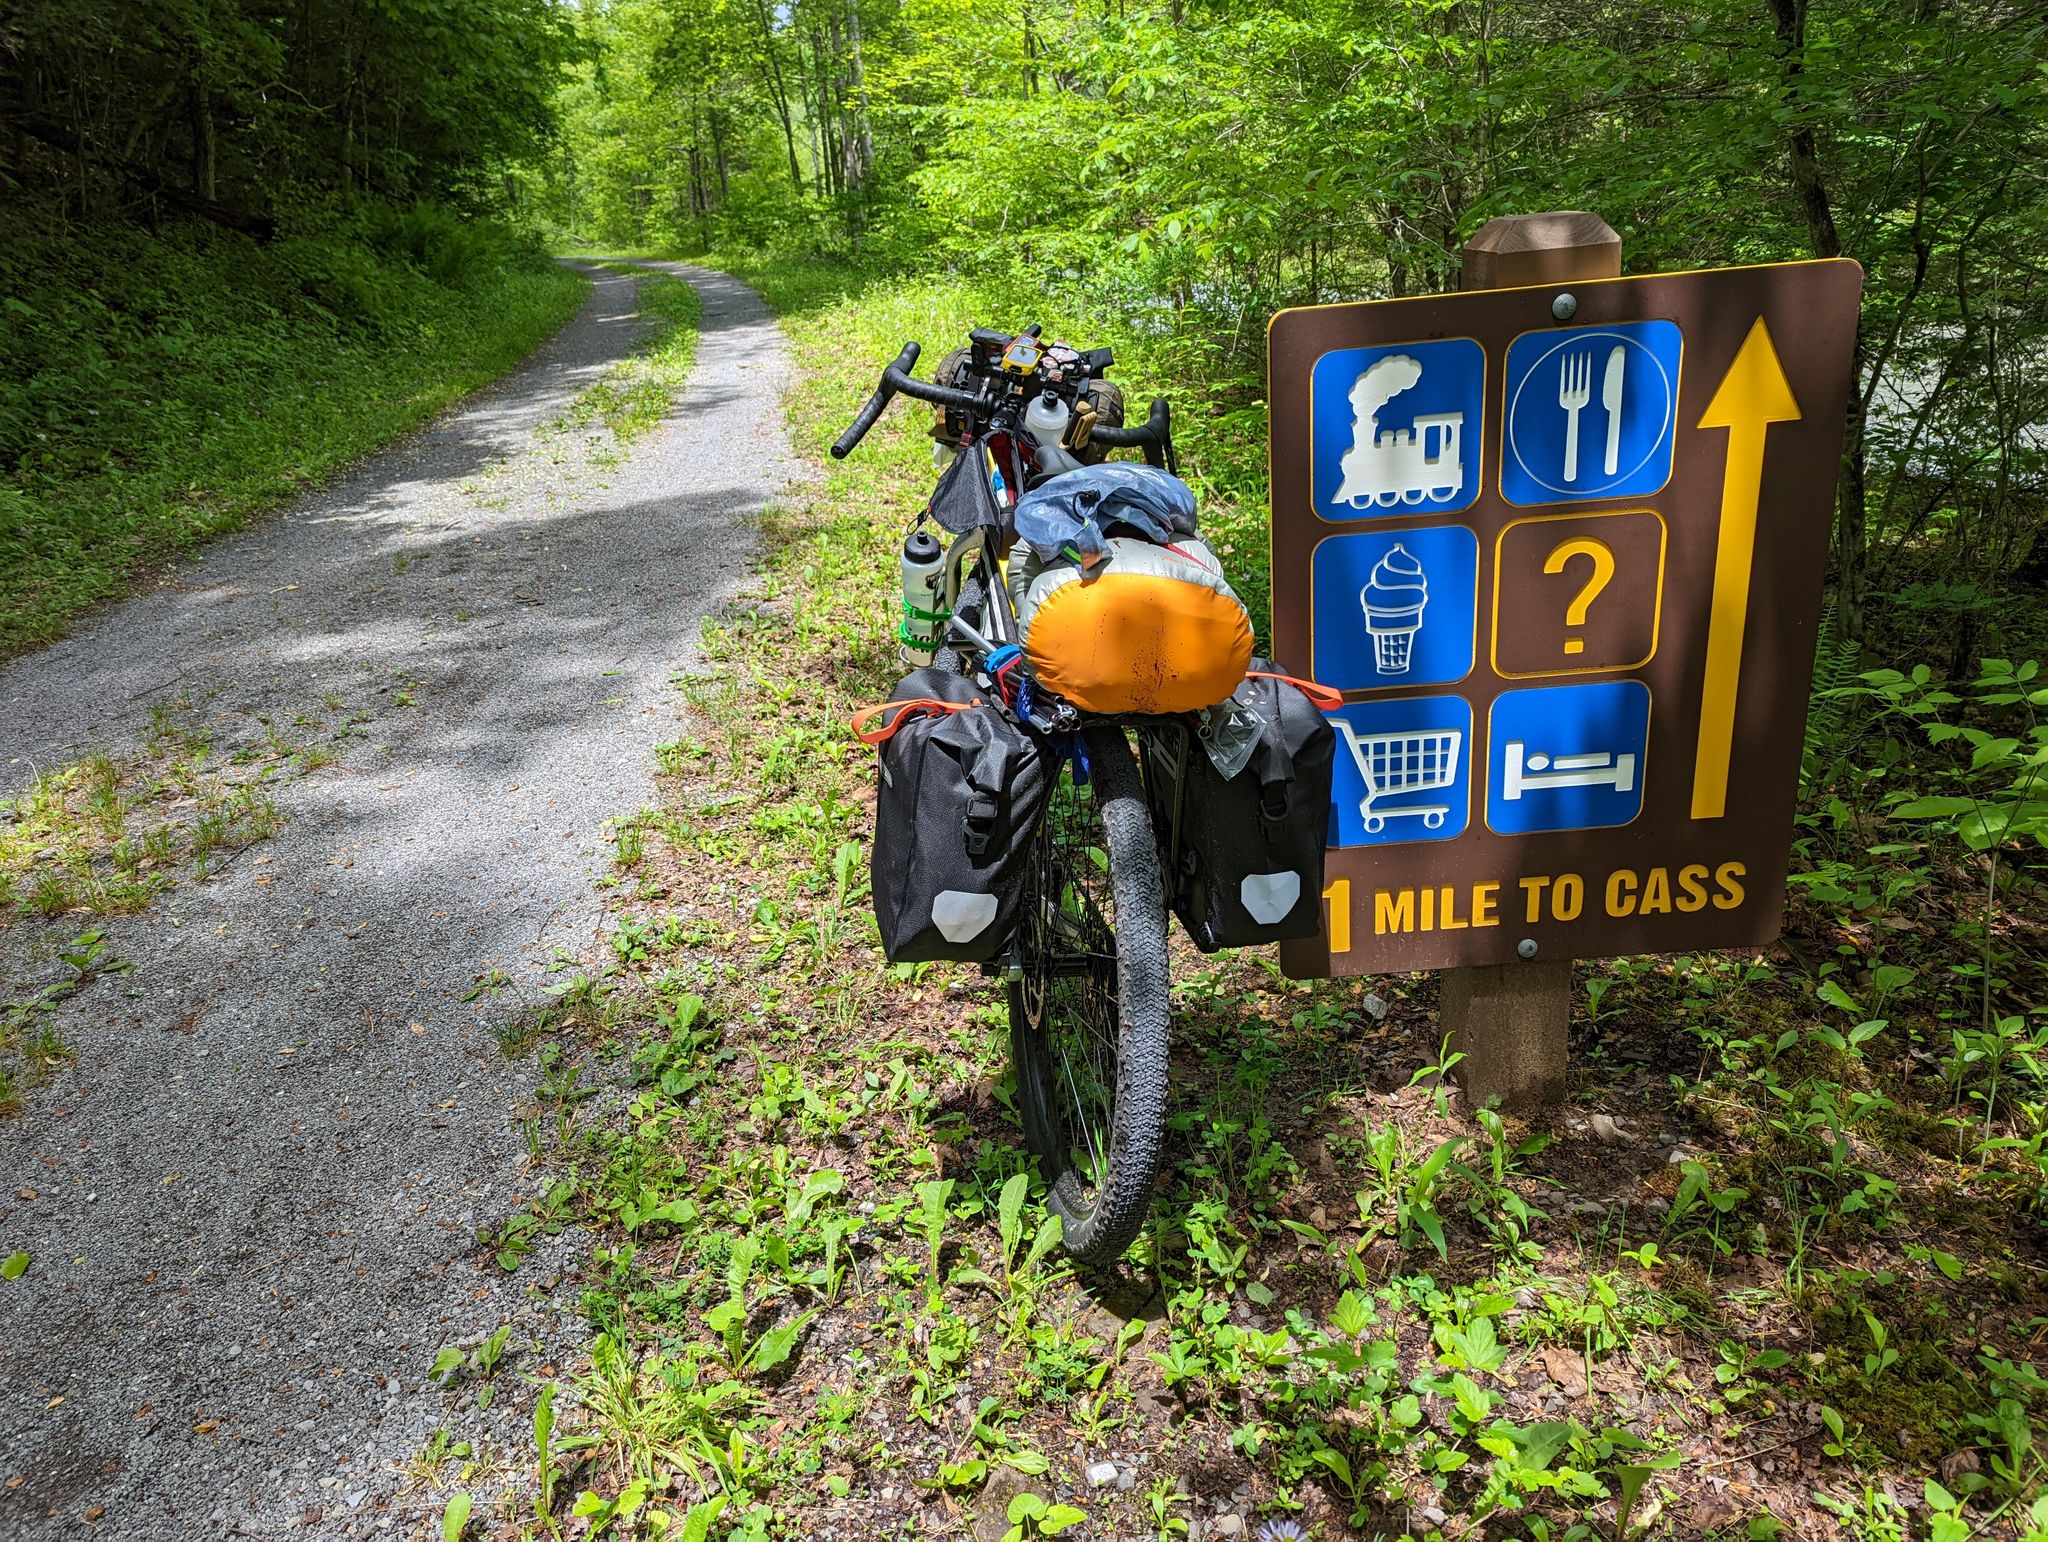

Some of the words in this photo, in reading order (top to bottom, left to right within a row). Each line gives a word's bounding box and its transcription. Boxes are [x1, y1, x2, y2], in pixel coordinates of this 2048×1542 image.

[1321, 876, 1352, 954] 1
[1373, 877, 1501, 935] MILE
[1518, 873, 1584, 923] TO
[1605, 861, 1747, 918] CASS
